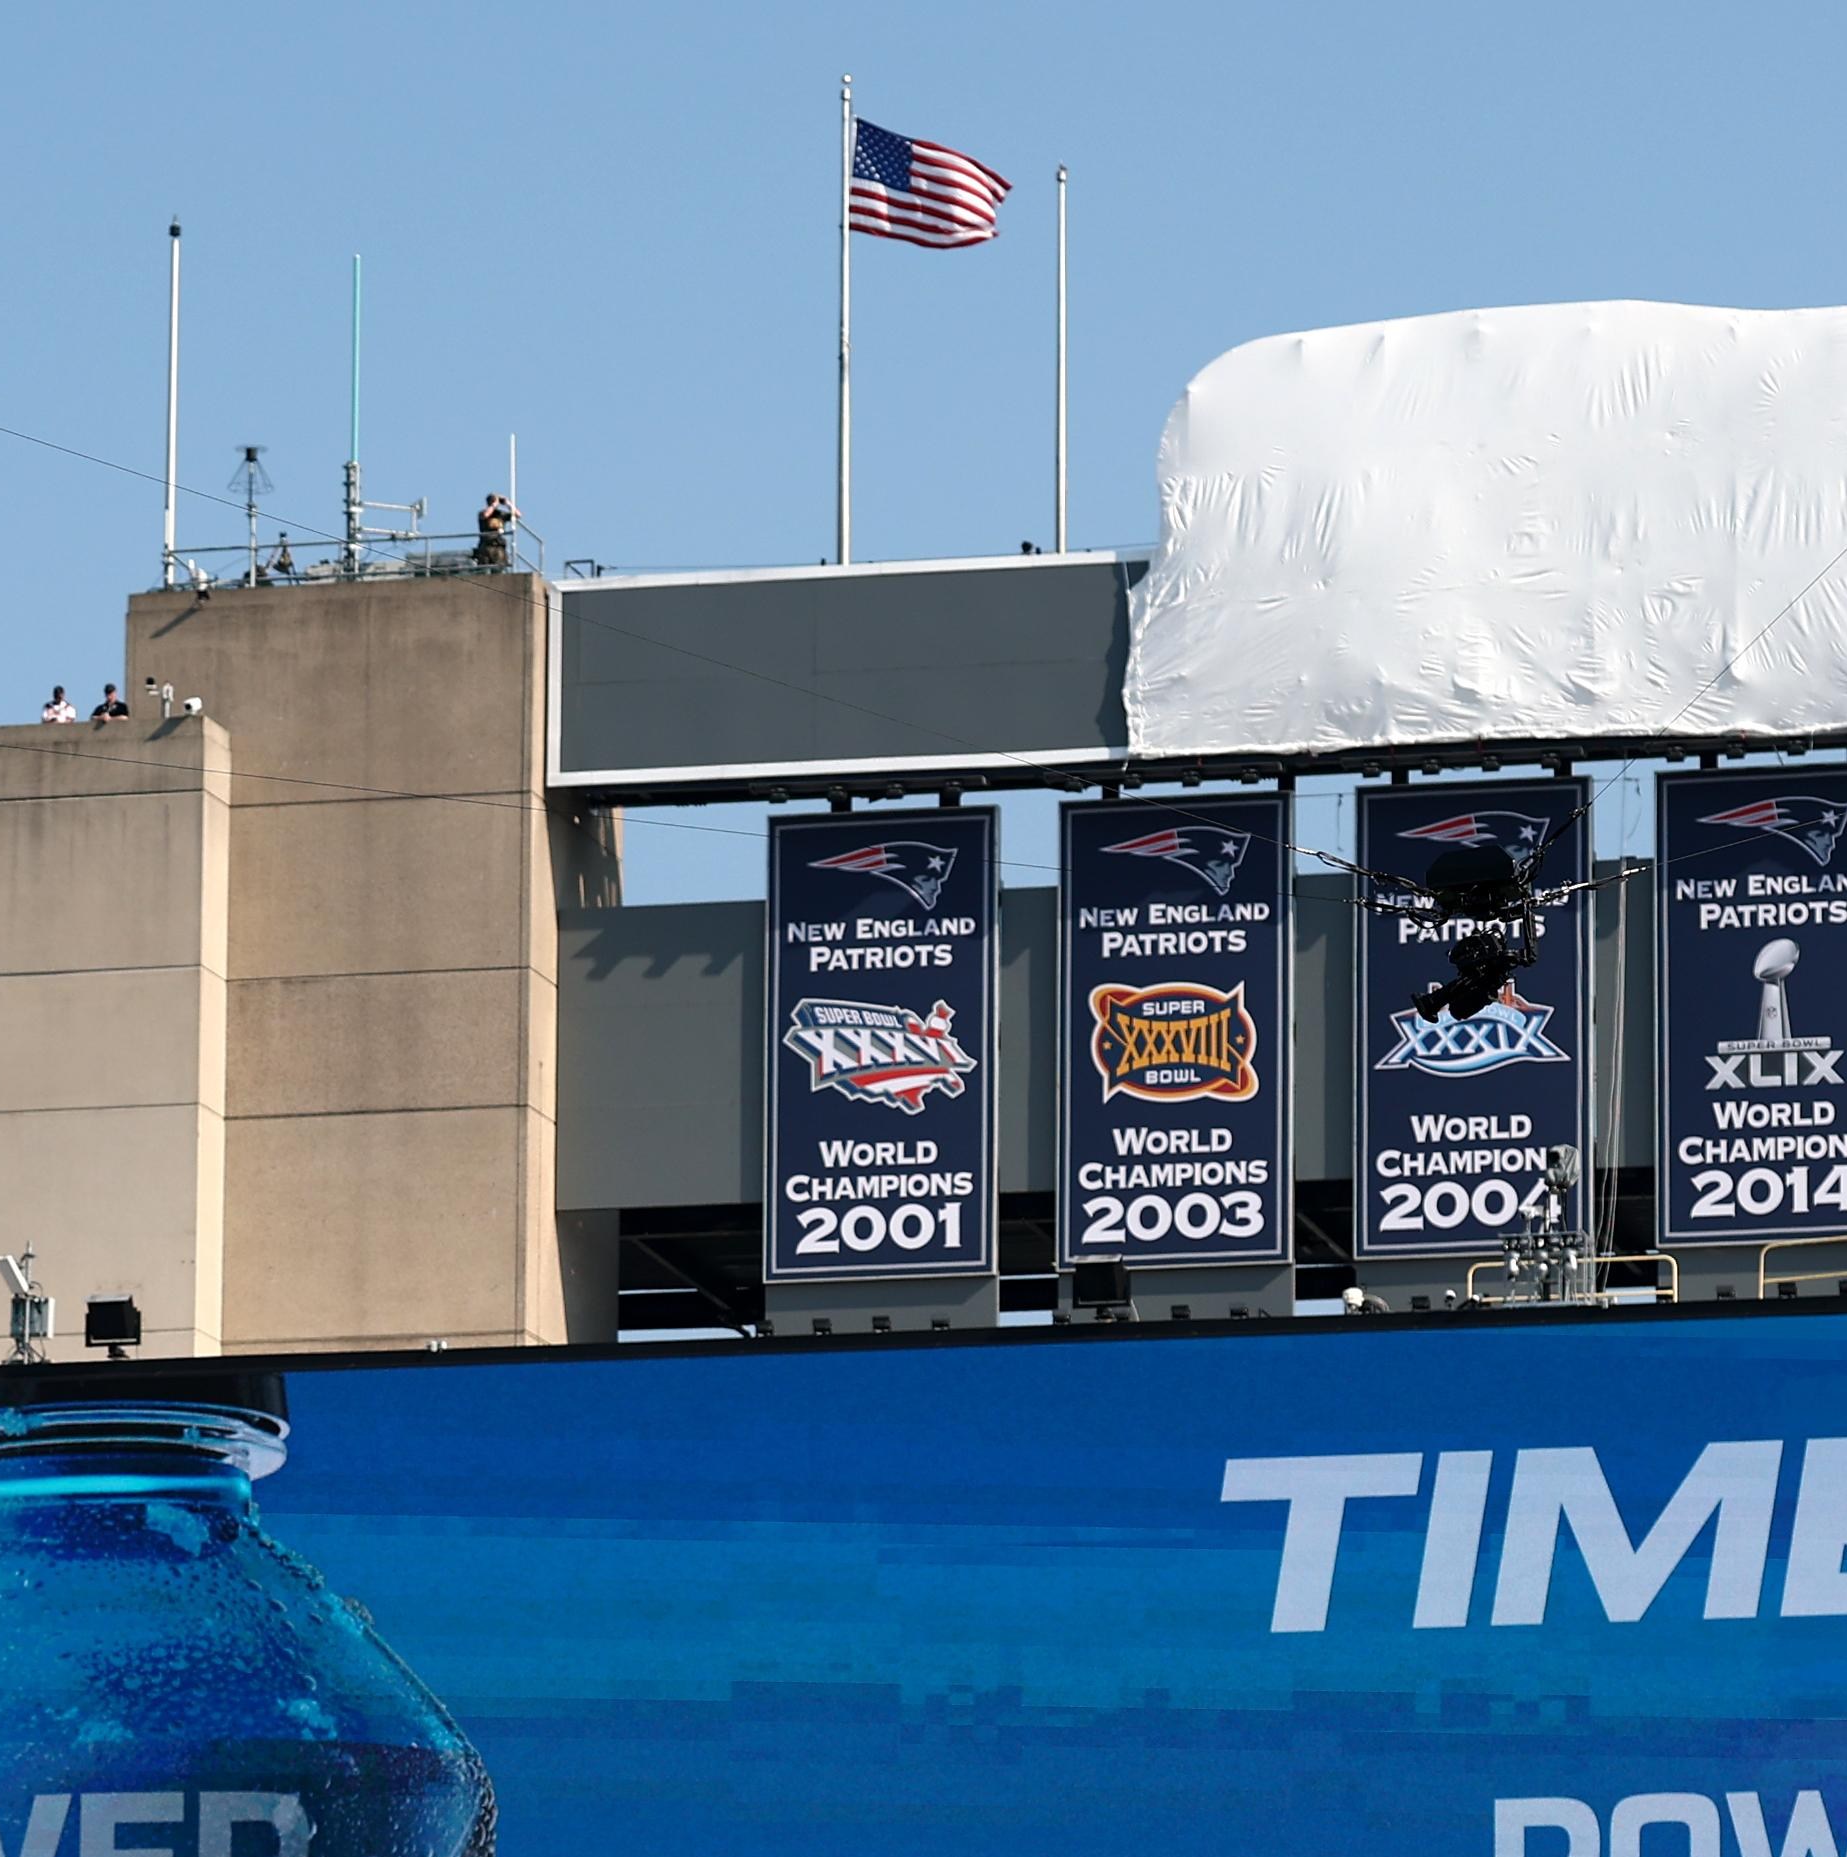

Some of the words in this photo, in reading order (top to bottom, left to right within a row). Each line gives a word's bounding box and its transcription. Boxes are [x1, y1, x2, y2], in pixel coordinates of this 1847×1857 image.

[1675, 876, 1735, 902] NEW
[787, 919, 843, 944] NEW
[851, 915, 976, 941] ENGLAND
[1079, 904, 1138, 930] NEW
[1144, 901, 1270, 926] ENGLAND
[1398, 914, 1546, 944] PATRTS
[808, 942, 953, 972] PATRIOTS
[1101, 930, 1247, 959] PATRIOTS
[814, 1006, 862, 1025] SUPER
[864, 1011, 903, 1028] BOWL
[1141, 998, 1206, 1017] SUPER
[797, 1028, 967, 1076] XXXVI
[1115, 1008, 1232, 1074] XXXVIII
[1726, 1038, 1768, 1051] SUPER
[1775, 1037, 1824, 1049] BOWL
[1145, 1067, 1202, 1085] BOWL
[1704, 1049, 1846, 1090] XLIX
[1410, 1113, 1532, 1143] WORLD
[1712, 1100, 1836, 1130] WORLD
[819, 1139, 938, 1168] WORLD
[1112, 1127, 1233, 1156] WORLD
[1078, 1158, 1269, 1190] CHAMPIONS
[1376, 1147, 1548, 1178] CHAMPION
[785, 1169, 974, 1201] CHAMPIONS
[1081, 1192, 1264, 1244] 2003
[1379, 1177, 1561, 1232] 2004
[795, 1203, 964, 1255] 2001
